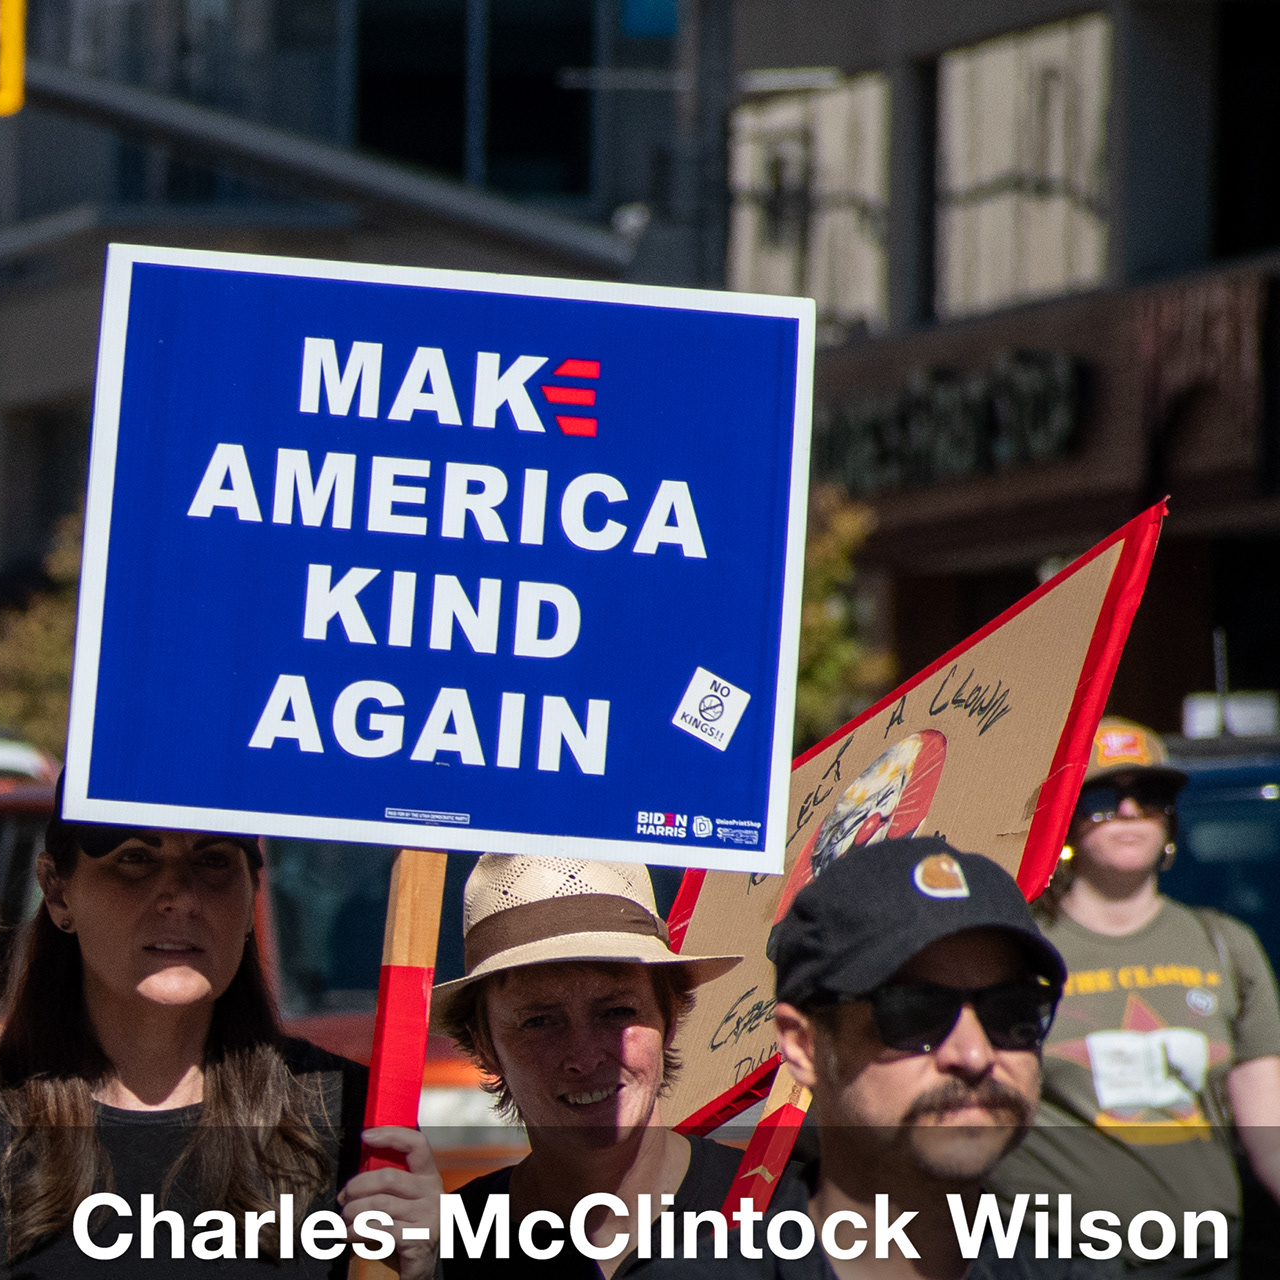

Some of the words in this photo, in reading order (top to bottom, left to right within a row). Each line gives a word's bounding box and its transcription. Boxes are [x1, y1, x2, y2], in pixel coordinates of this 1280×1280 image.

[298, 336, 601, 437] MAKE
[187, 442, 708, 559] AMERICA
[302, 563, 582, 659] KIND
[709, 679, 731, 698] NO
[248, 673, 610, 776] AGAIN
[680, 711, 725, 742] KINGS!!
[883, 694, 907, 739] A
[636, 824, 687, 838] HARRIS
[637, 811, 688, 827] BIDEN
